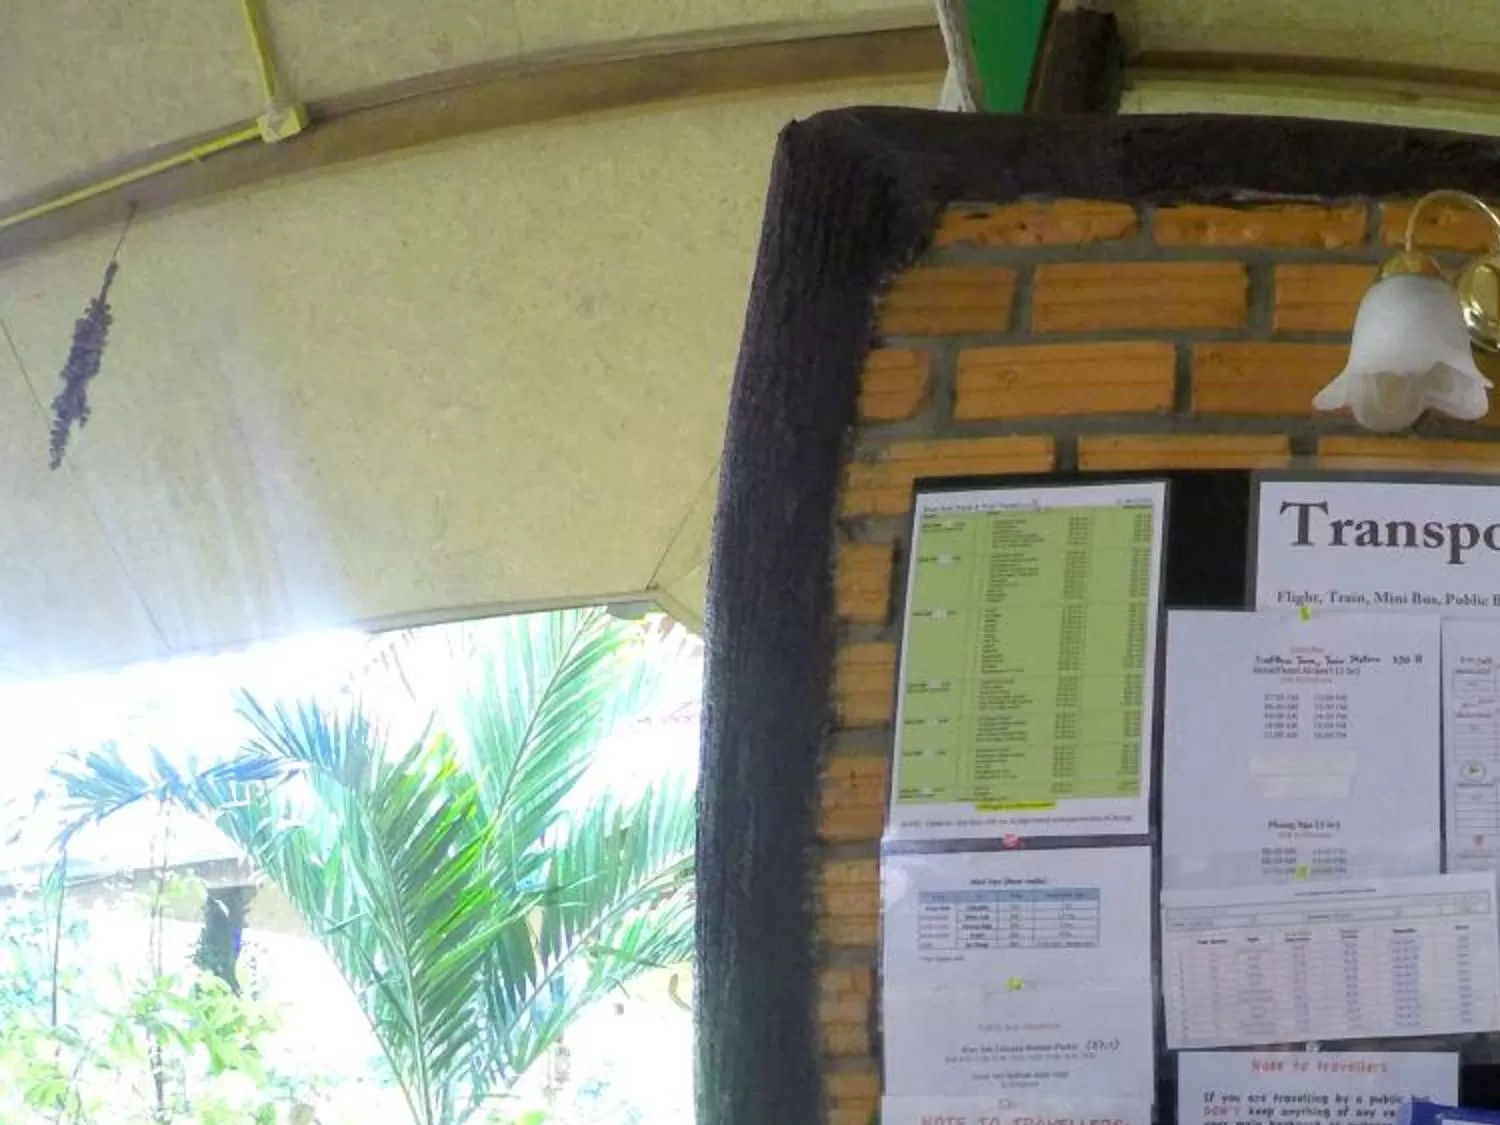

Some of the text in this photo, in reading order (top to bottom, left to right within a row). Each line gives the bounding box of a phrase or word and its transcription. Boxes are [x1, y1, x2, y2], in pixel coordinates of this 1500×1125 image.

[1277, 591, 1322, 606] Flight,
[1327, 591, 1370, 605] Train,
[1374, 591, 1408, 604] Mini
[1412, 592, 1442, 606] Bus,
[1445, 592, 1489, 606] Public
